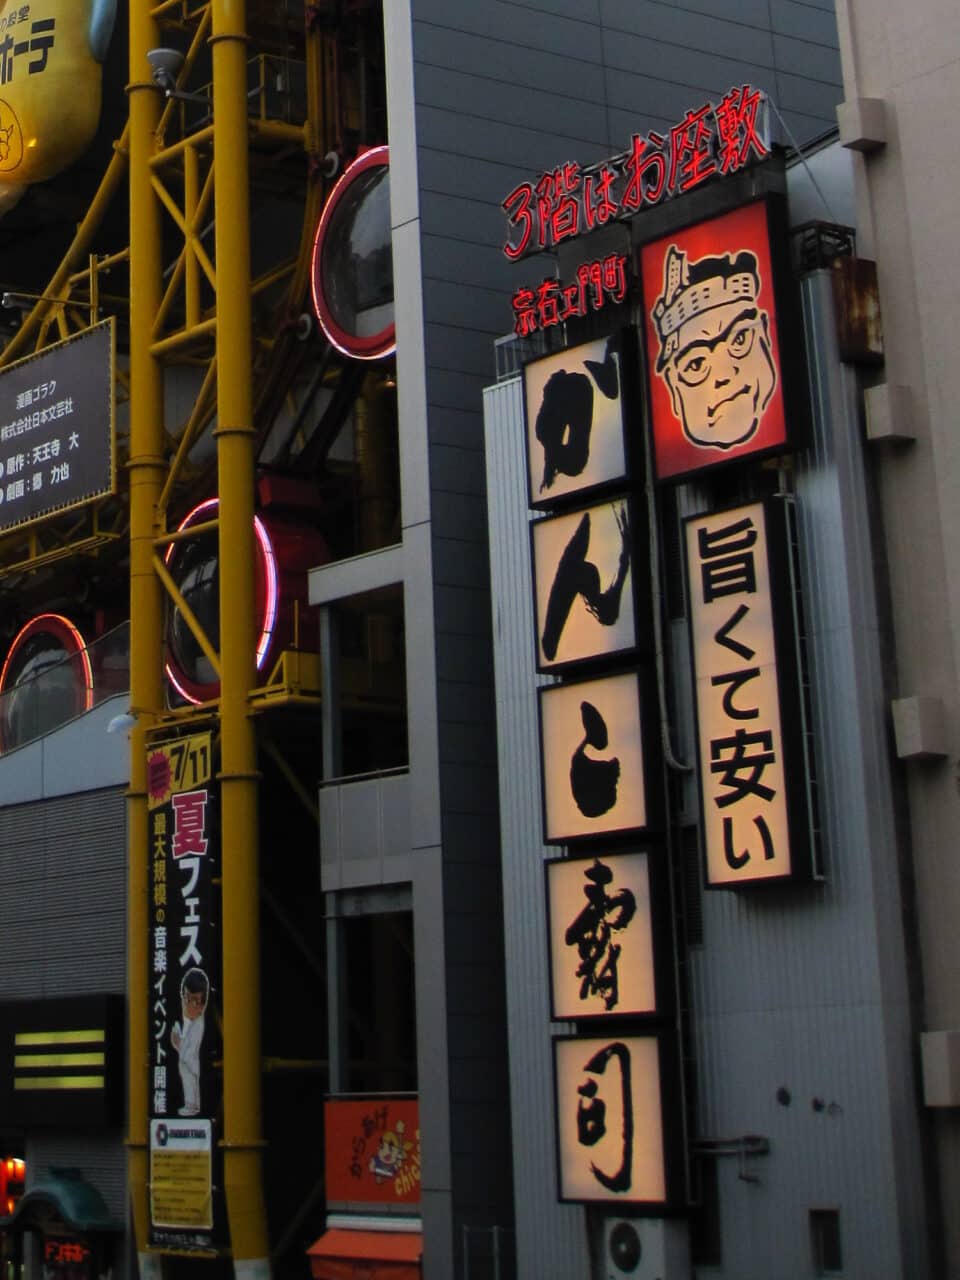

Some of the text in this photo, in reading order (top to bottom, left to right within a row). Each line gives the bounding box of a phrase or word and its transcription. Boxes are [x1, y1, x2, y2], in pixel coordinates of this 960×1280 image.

[501, 83, 770, 263] 3階はお座敷
[16, 380, 57, 410] 漫画ゴラク
[697, 518, 778, 872] 旨くて安い
[170, 741, 208, 789] 7/11
